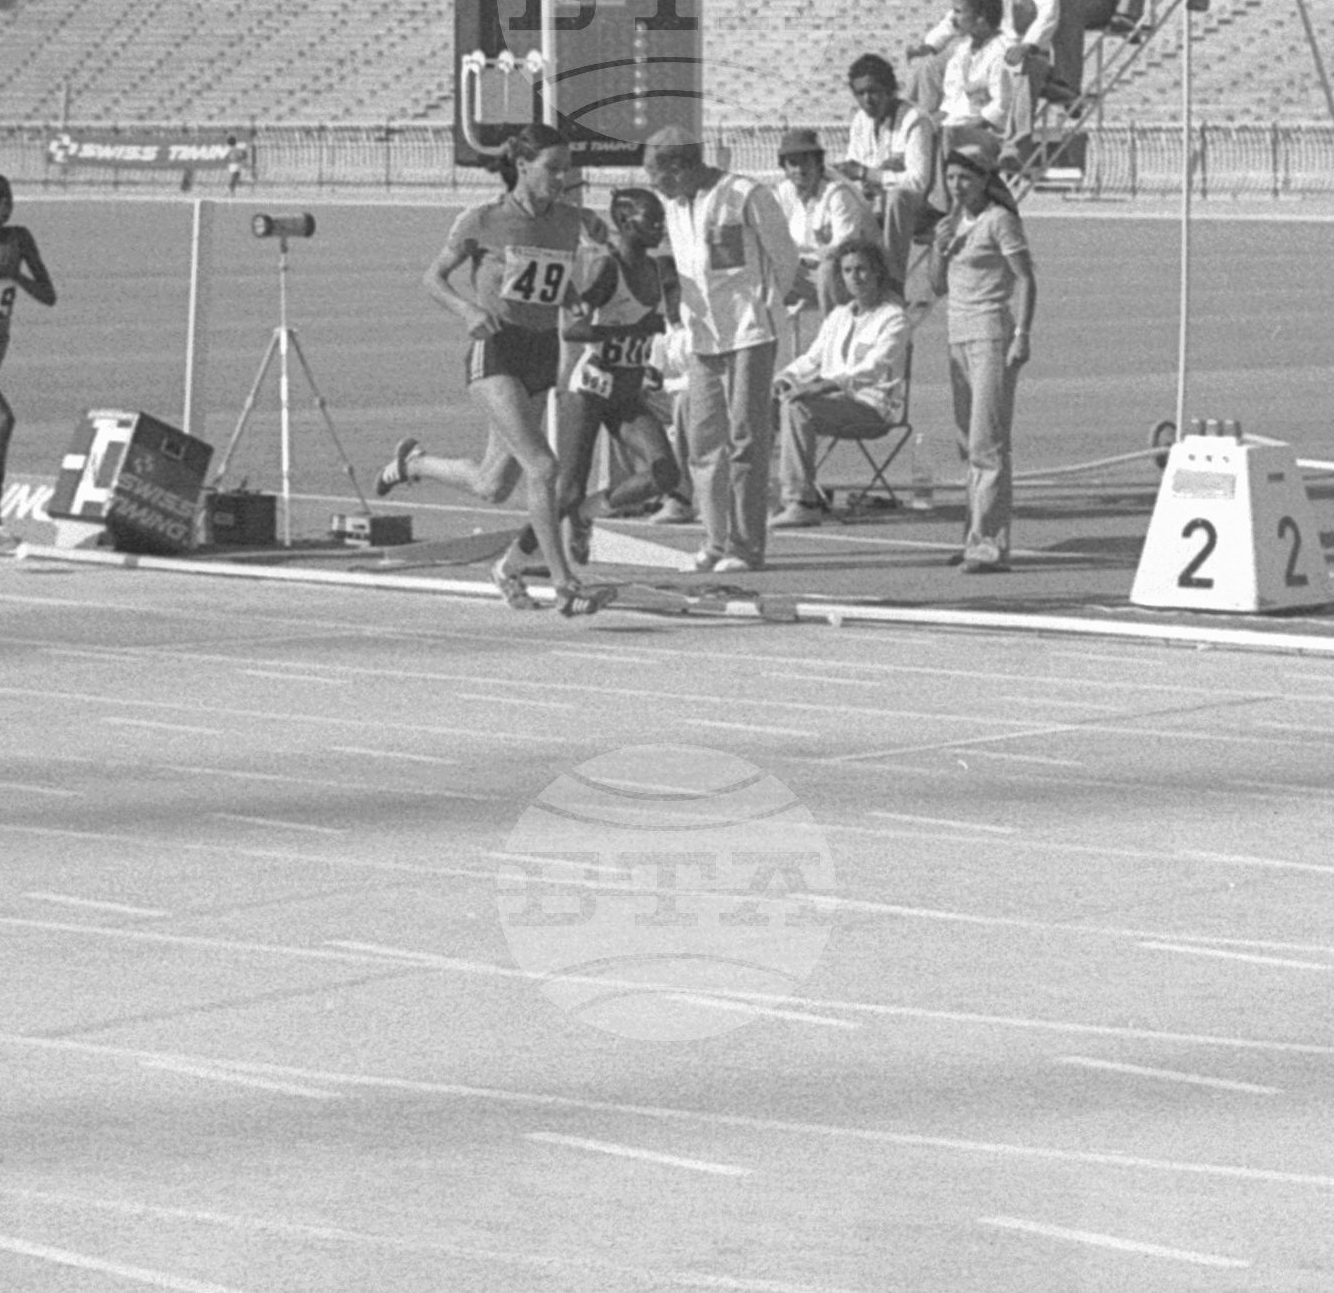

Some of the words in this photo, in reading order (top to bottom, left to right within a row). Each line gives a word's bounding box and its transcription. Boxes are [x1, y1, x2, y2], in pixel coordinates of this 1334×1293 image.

[78, 142, 159, 162] SWISS
[169, 142, 247, 161] TIMIN
[512, 260, 565, 303] 49
[119, 472, 196, 518] SWISS
[1178, 517, 1218, 589] 2
[1277, 515, 1309, 588] 2
